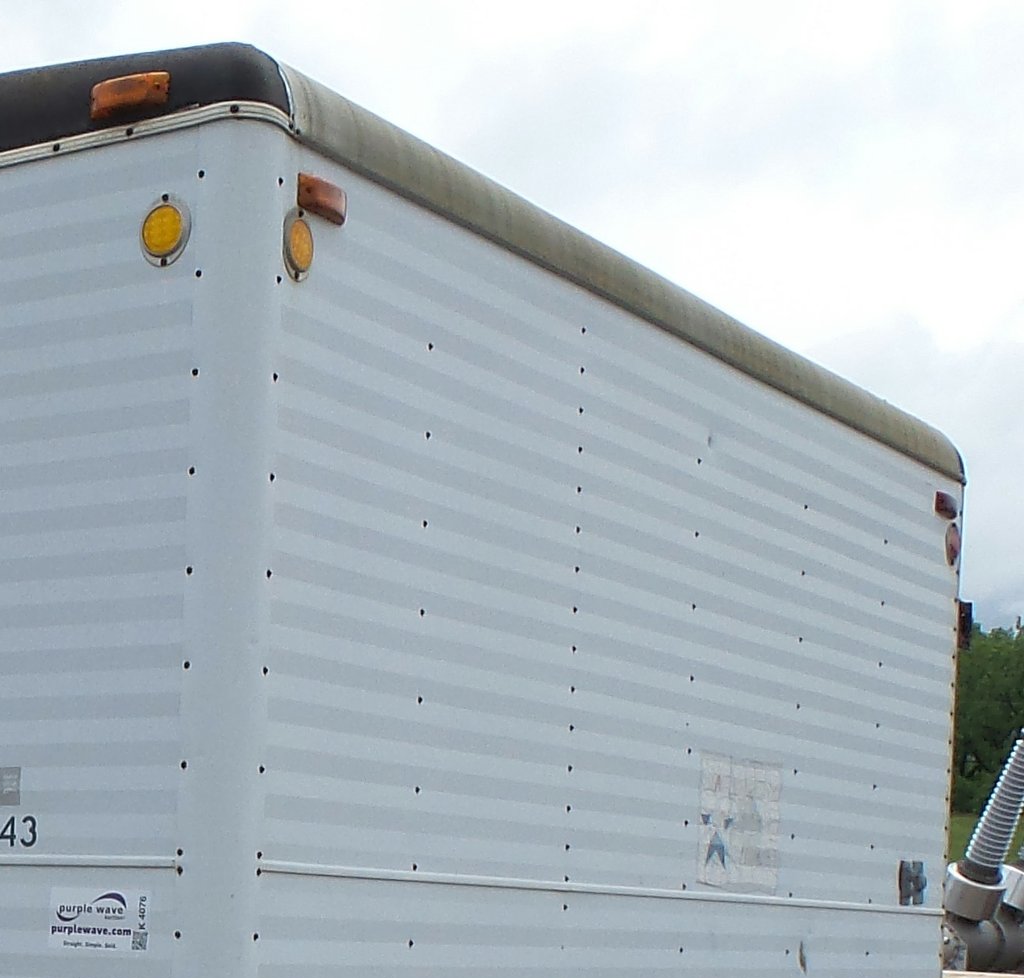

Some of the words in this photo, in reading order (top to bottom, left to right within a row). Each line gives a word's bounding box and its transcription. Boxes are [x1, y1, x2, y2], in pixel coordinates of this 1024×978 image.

[59, 904, 92, 915] purple
[96, 906, 123, 915] wave
[51, 924, 132, 936] purplewave.com
[138, 922, 146, 930] K
